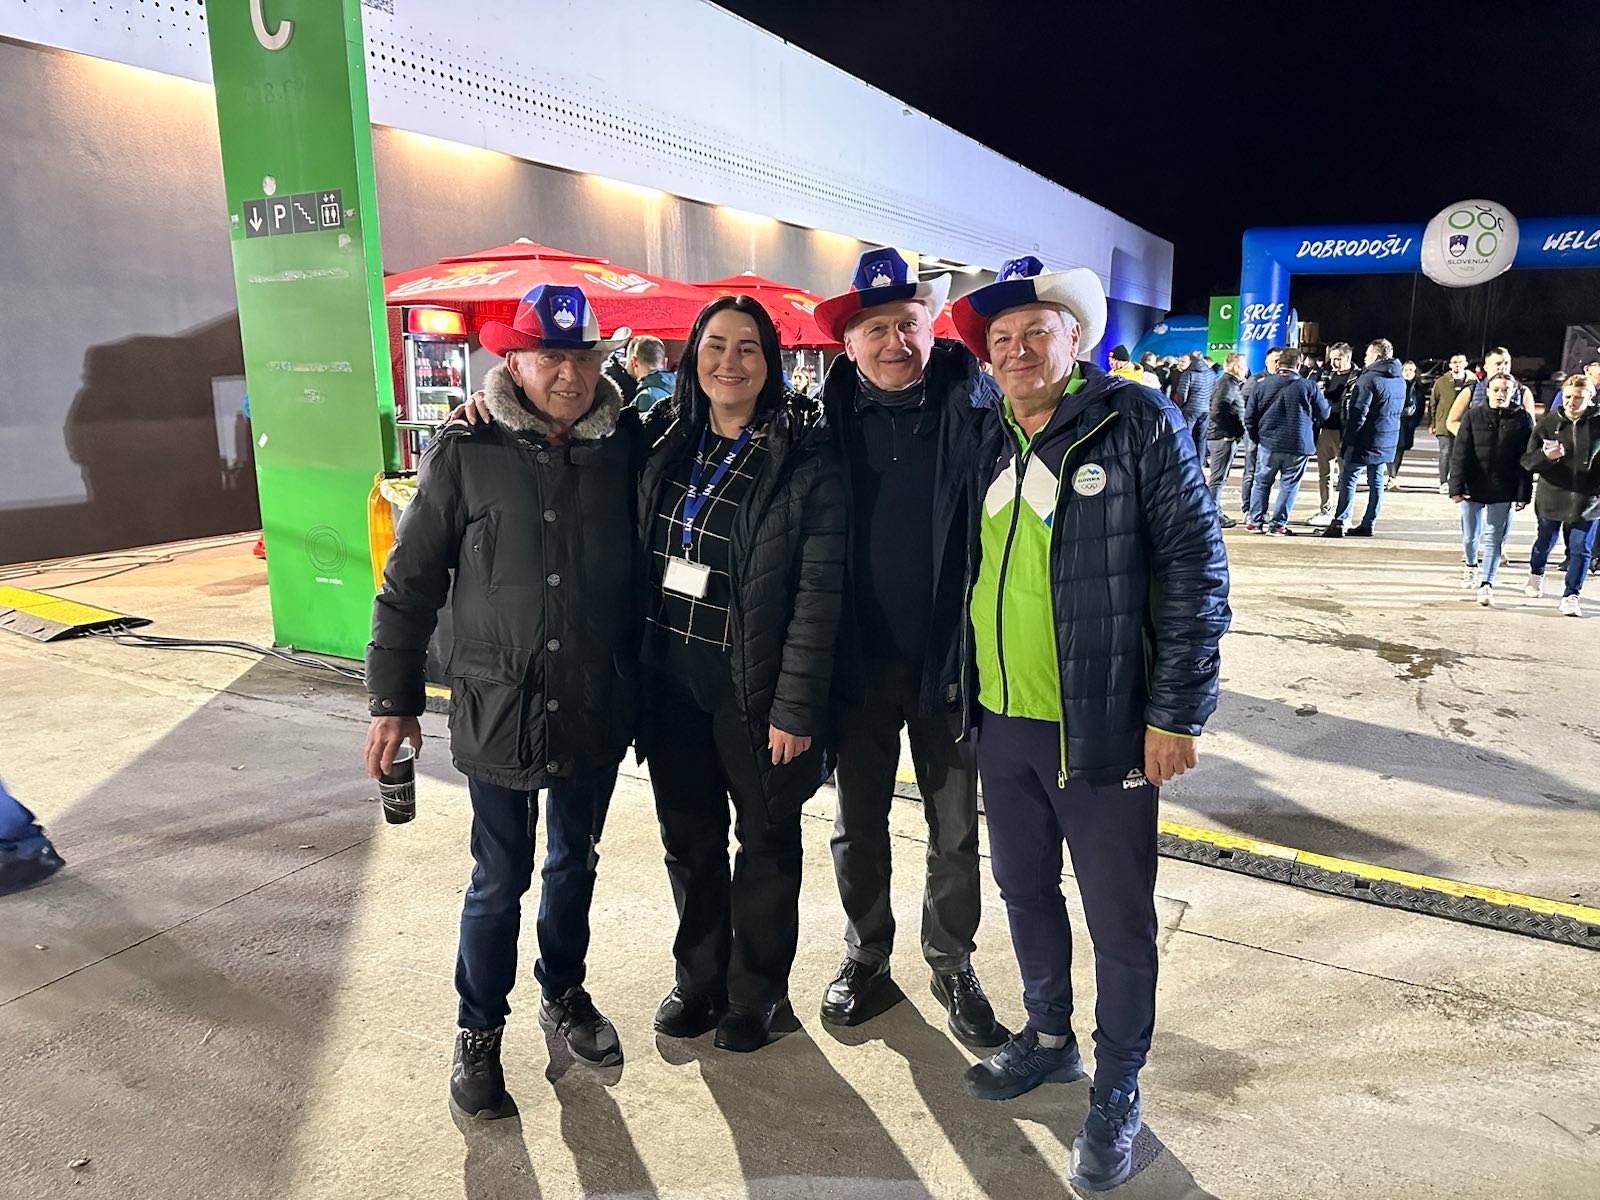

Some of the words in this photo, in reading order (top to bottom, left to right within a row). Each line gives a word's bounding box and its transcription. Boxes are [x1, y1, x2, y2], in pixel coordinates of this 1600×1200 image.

[274, 204, 286, 229] P
[1296, 233, 1413, 259] DOBRODOŠLI
[1219, 303, 1233, 320] C
[1240, 303, 1284, 324] SRCE
[1240, 322, 1280, 341] BIJE
[1122, 776, 1148, 790] PEAK
